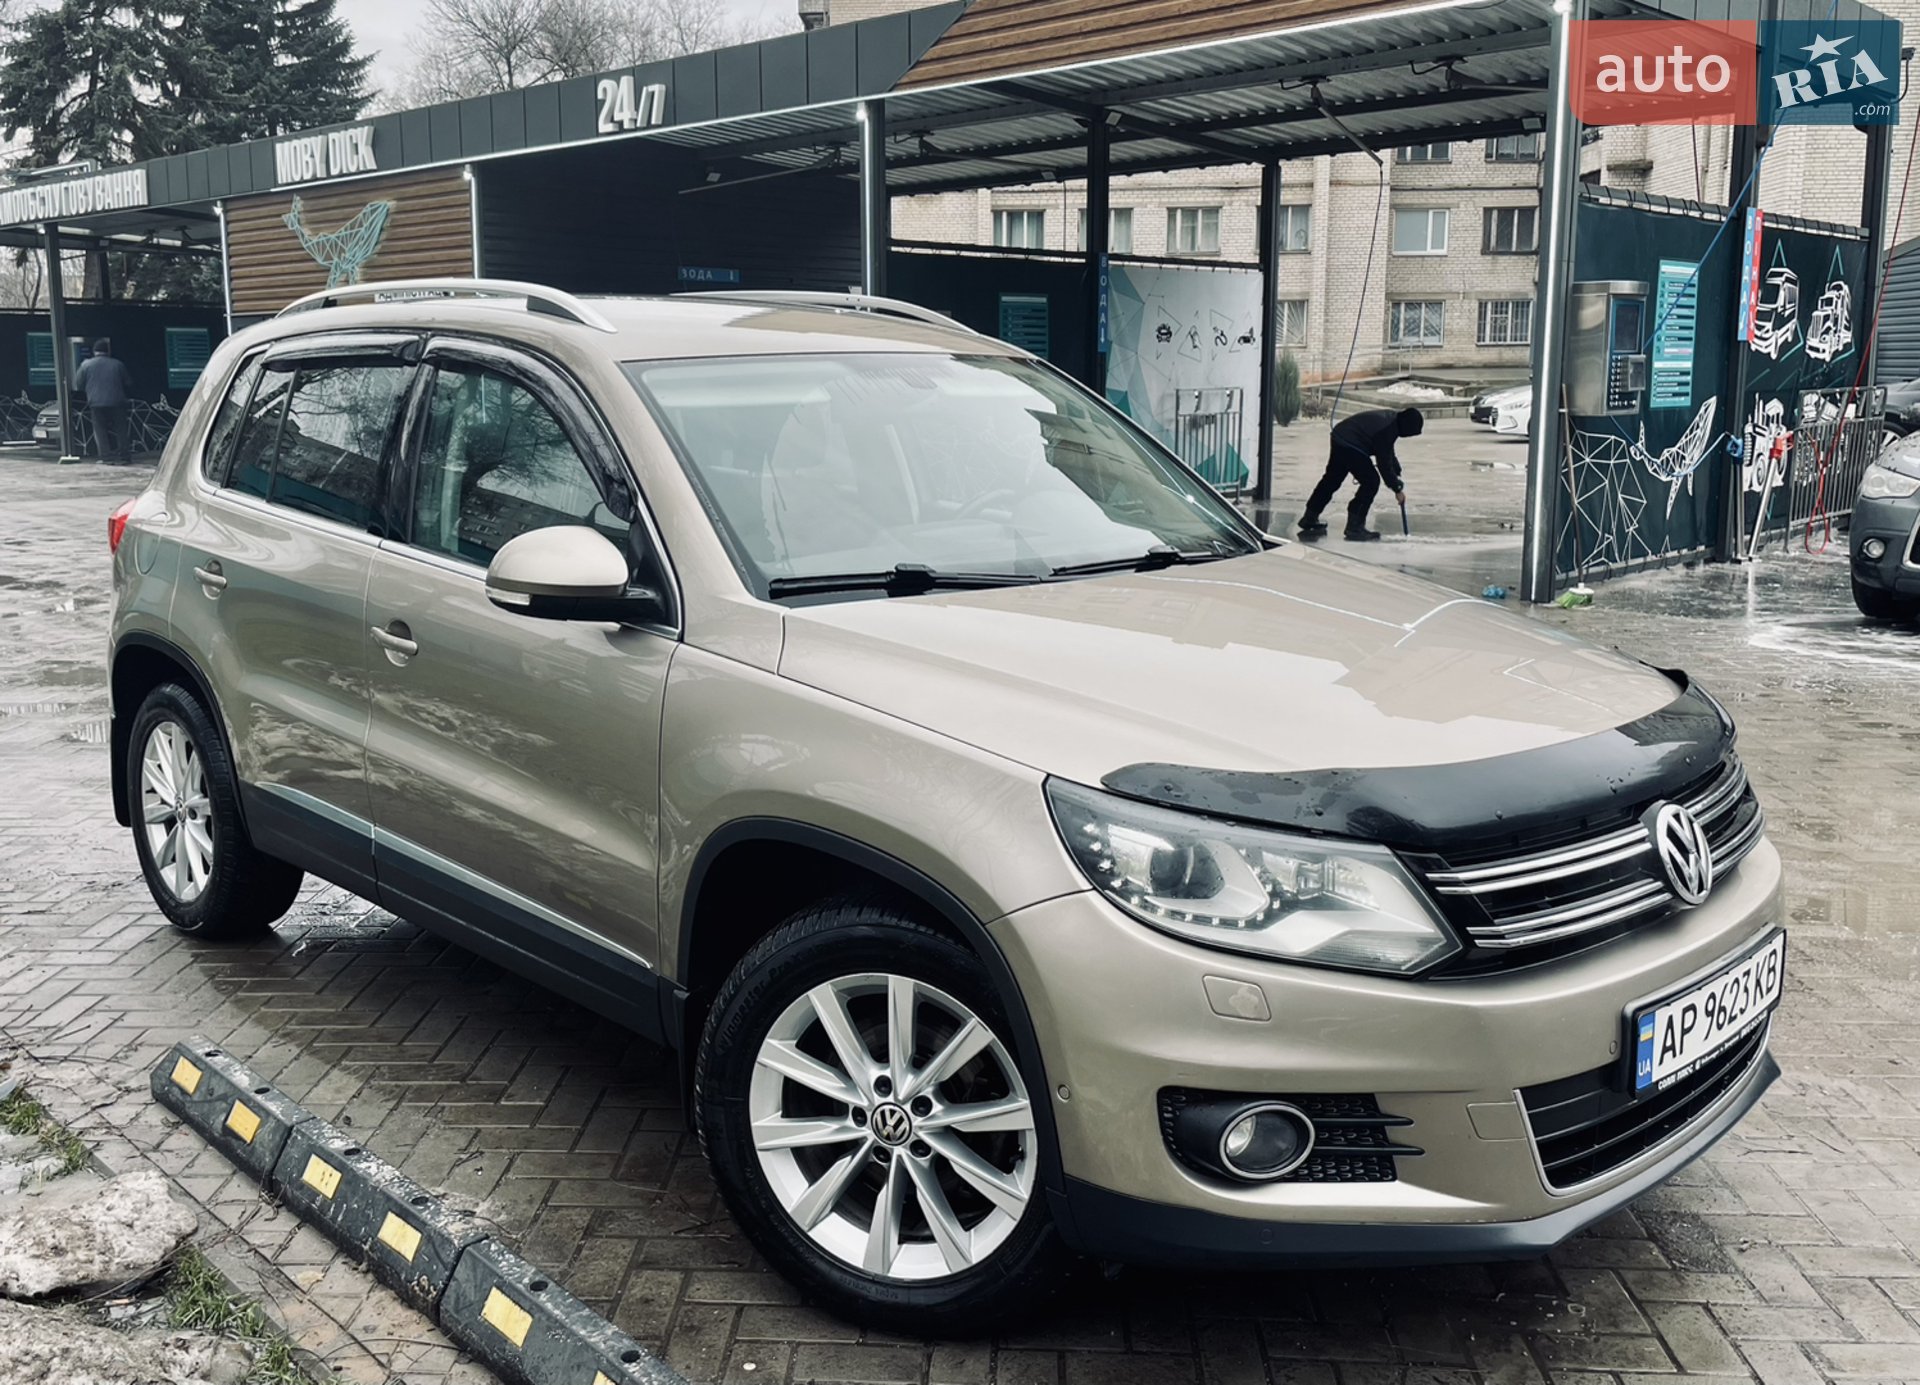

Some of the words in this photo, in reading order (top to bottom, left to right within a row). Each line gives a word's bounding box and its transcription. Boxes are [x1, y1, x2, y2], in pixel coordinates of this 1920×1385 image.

[597, 75, 666, 133] 24/7
[276, 135, 328, 184] MOBY
[328, 126, 377, 176] DICK
[1099, 255, 1108, 324] ВОДА
[1658, 1003, 1697, 1067] AP
[1703, 968, 1752, 1041] 9623
[1752, 948, 1778, 1007] KB
[1638, 1058, 1652, 1077] UA
